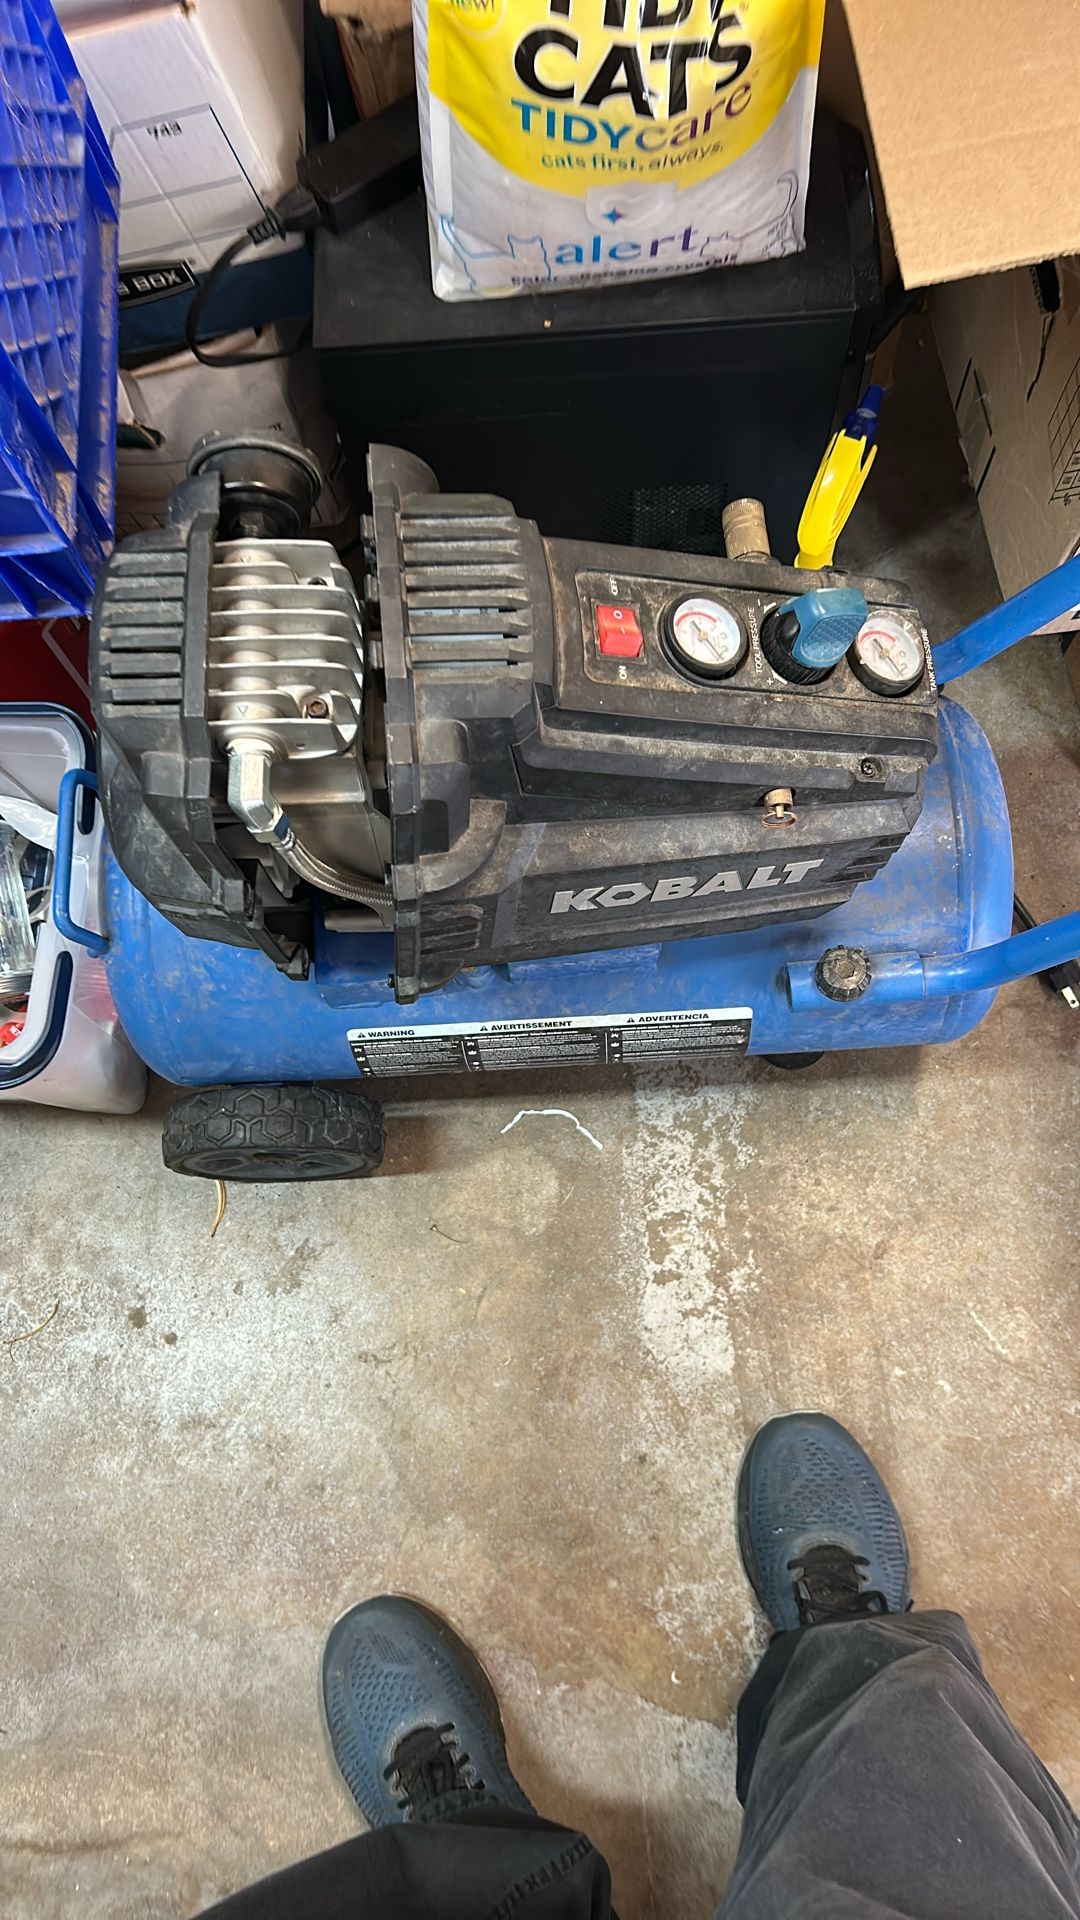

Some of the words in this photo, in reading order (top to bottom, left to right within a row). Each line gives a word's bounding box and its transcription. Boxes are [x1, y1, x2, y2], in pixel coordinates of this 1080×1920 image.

[513, 13, 753, 120] CATS
[511, 83, 753, 152] TIDYcare
[541, 154, 586, 169] cats
[592, 152, 644, 172] first,
[555, 226, 699, 267] alert
[748, 606, 761, 650] PRESSURE
[920, 628, 934, 670] PRESSURE
[619, 665, 628, 680] ON
[754, 651, 763, 673] TOOL
[928, 671, 937, 692] TANK
[550, 858, 825, 914] KOBALT
[490, 1020, 573, 1031] AVERTISSEMENT
[638, 1013, 709, 1023] ADVERTENCIA
[368, 1029, 415, 1038] WARNING
